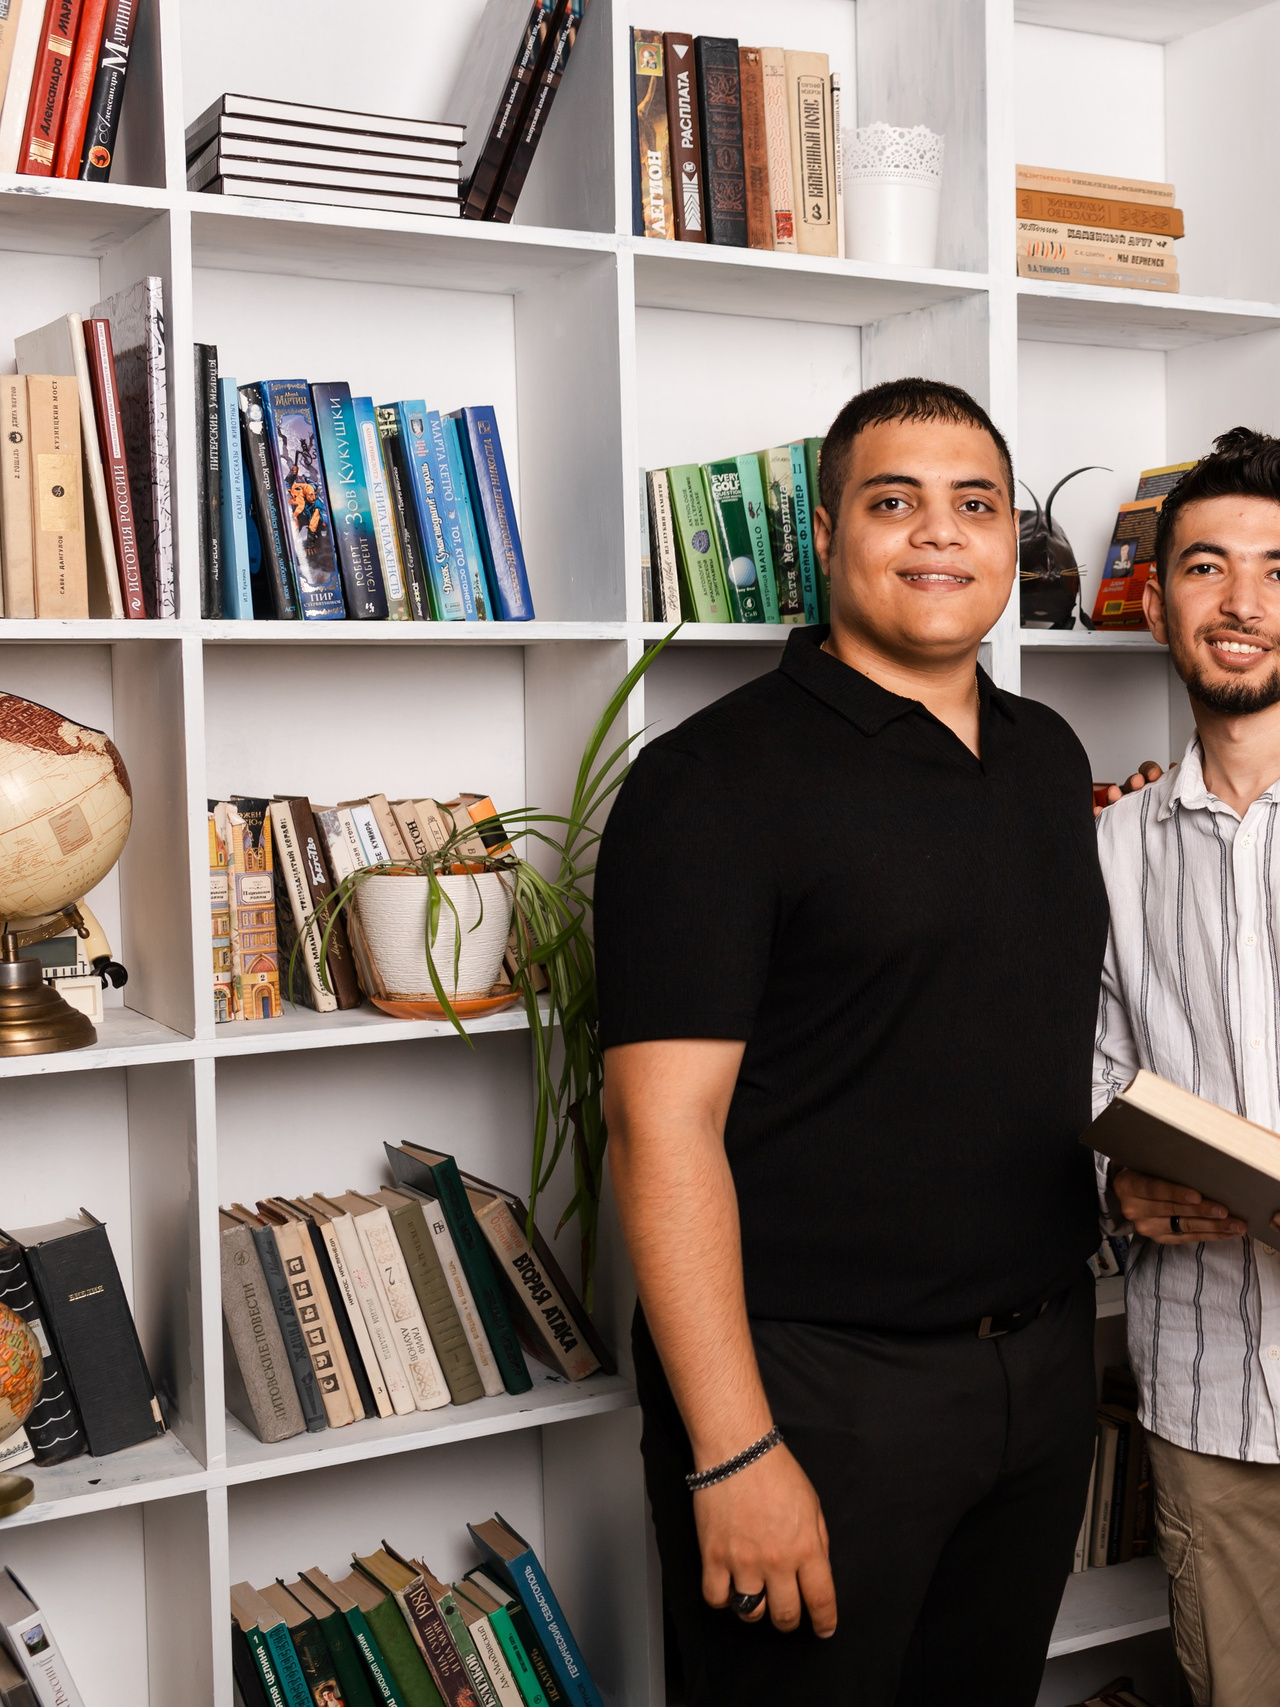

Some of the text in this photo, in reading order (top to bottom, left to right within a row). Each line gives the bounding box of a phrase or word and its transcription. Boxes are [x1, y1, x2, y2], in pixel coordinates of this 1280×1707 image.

[40, 57, 63, 137] Александра
[98, 71, 118, 144] Александра
[496, 104, 512, 139] выпускной
[508, 81, 520, 104] альбом
[526, 108, 541, 143] выпускной
[538, 86, 549, 109] альбом
[681, 70, 694, 149] РАСПЛАТА
[803, 99, 821, 129] ПОЯС
[804, 131, 824, 198] КАМЕННЫЙ
[650, 150, 666, 236] ЛЕГИОН
[1047, 197, 1099, 212] ХУДОЖНИК
[1047, 207, 1105, 223] ИСКУССТВО
[1117, 253, 1129, 263] МЫ
[1131, 255, 1165, 267] ВЕРНЕМСЯ
[208, 359, 219, 471] ПИТЕРСКИЕ УМЕЛЬЦЫ
[275, 394, 308, 406] МАРТИН
[230, 402, 238, 439] ЖИВОТНЫХ
[233, 449, 243, 485] РАССКАЗЫ
[258, 442, 268, 467] Марта
[483, 438, 502, 485] НИКОГДА
[51, 380, 66, 595] САВВА ДАНГУЛОВ КУЗНЕЦКИЙ МОСТ
[262, 468, 272, 490] Кетро
[421, 462, 434, 494] король
[430, 420, 443, 462] МАРТА
[438, 463, 454, 502] КЕТРО
[455, 547, 465, 567] КТО
[711, 472, 740, 484] EVERY
[712, 481, 741, 492] GOLF
[236, 497, 245, 520] СКАЗКИ
[267, 493, 279, 529] Улыбайся
[493, 487, 513, 549] ПОМЕРКНЕТ
[682, 488, 693, 527] ANTHOLOGIE
[113, 465, 140, 592] ИСТОРИЯ РОССИИ
[373, 482, 387, 521] КНИГА
[381, 523, 400, 595] БЛАЖЕНСТВ
[779, 484, 799, 609] Катя Метелица
[350, 545, 365, 587] РОБЕРТ
[359, 536, 378, 593] ГЭЛБРЕЙТ
[506, 550, 517, 566] НЕ
[708, 558, 720, 597] ЭПИГРАММЫ
[755, 526, 771, 608] матрица MANOLO
[801, 543, 813, 593] Джеймс
[310, 592, 334, 602] ПИР
[697, 560, 708, 597] АНТОЛОГИЯ
[703, 559, 716, 603] ФРАНЦУЗСКОЙ
[344, 821, 357, 844] стена
[364, 820, 380, 849] КУМИРА
[286, 850, 307, 911] ТРИНАДЦАТЫЙ
[260, 974, 266, 982] 2
[384, 1266, 396, 1287] 2
[511, 1252, 579, 1355] ВТОРАЯ АТАКА
[242, 1282, 288, 1421] ЛИТОВСКИЕ ПОВЕСТИ
[285, 1324, 308, 1364] ЖАННА
[400, 1327, 419, 1363] АХУНОВ
[410, 1326, 426, 1355] ГАРИФ
[409, 1585, 434, 1621] 1981
[525, 1565, 580, 1679] ГЕРОИЧЕСКИЙ СЕВАСТОПОЛЬ
[423, 1623, 441, 1655] СУШЕ
[431, 1618, 448, 1646] МОРЕ
[477, 1625, 504, 1676] Молдавский
[256, 1645, 275, 1687] ЦЕЛИНА
[356, 1633, 390, 1698] МИХАИЛ ШОЛОХОВ
[444, 1646, 457, 1662] НА
[529, 1648, 561, 1702] ПСАЛТИРЬ
